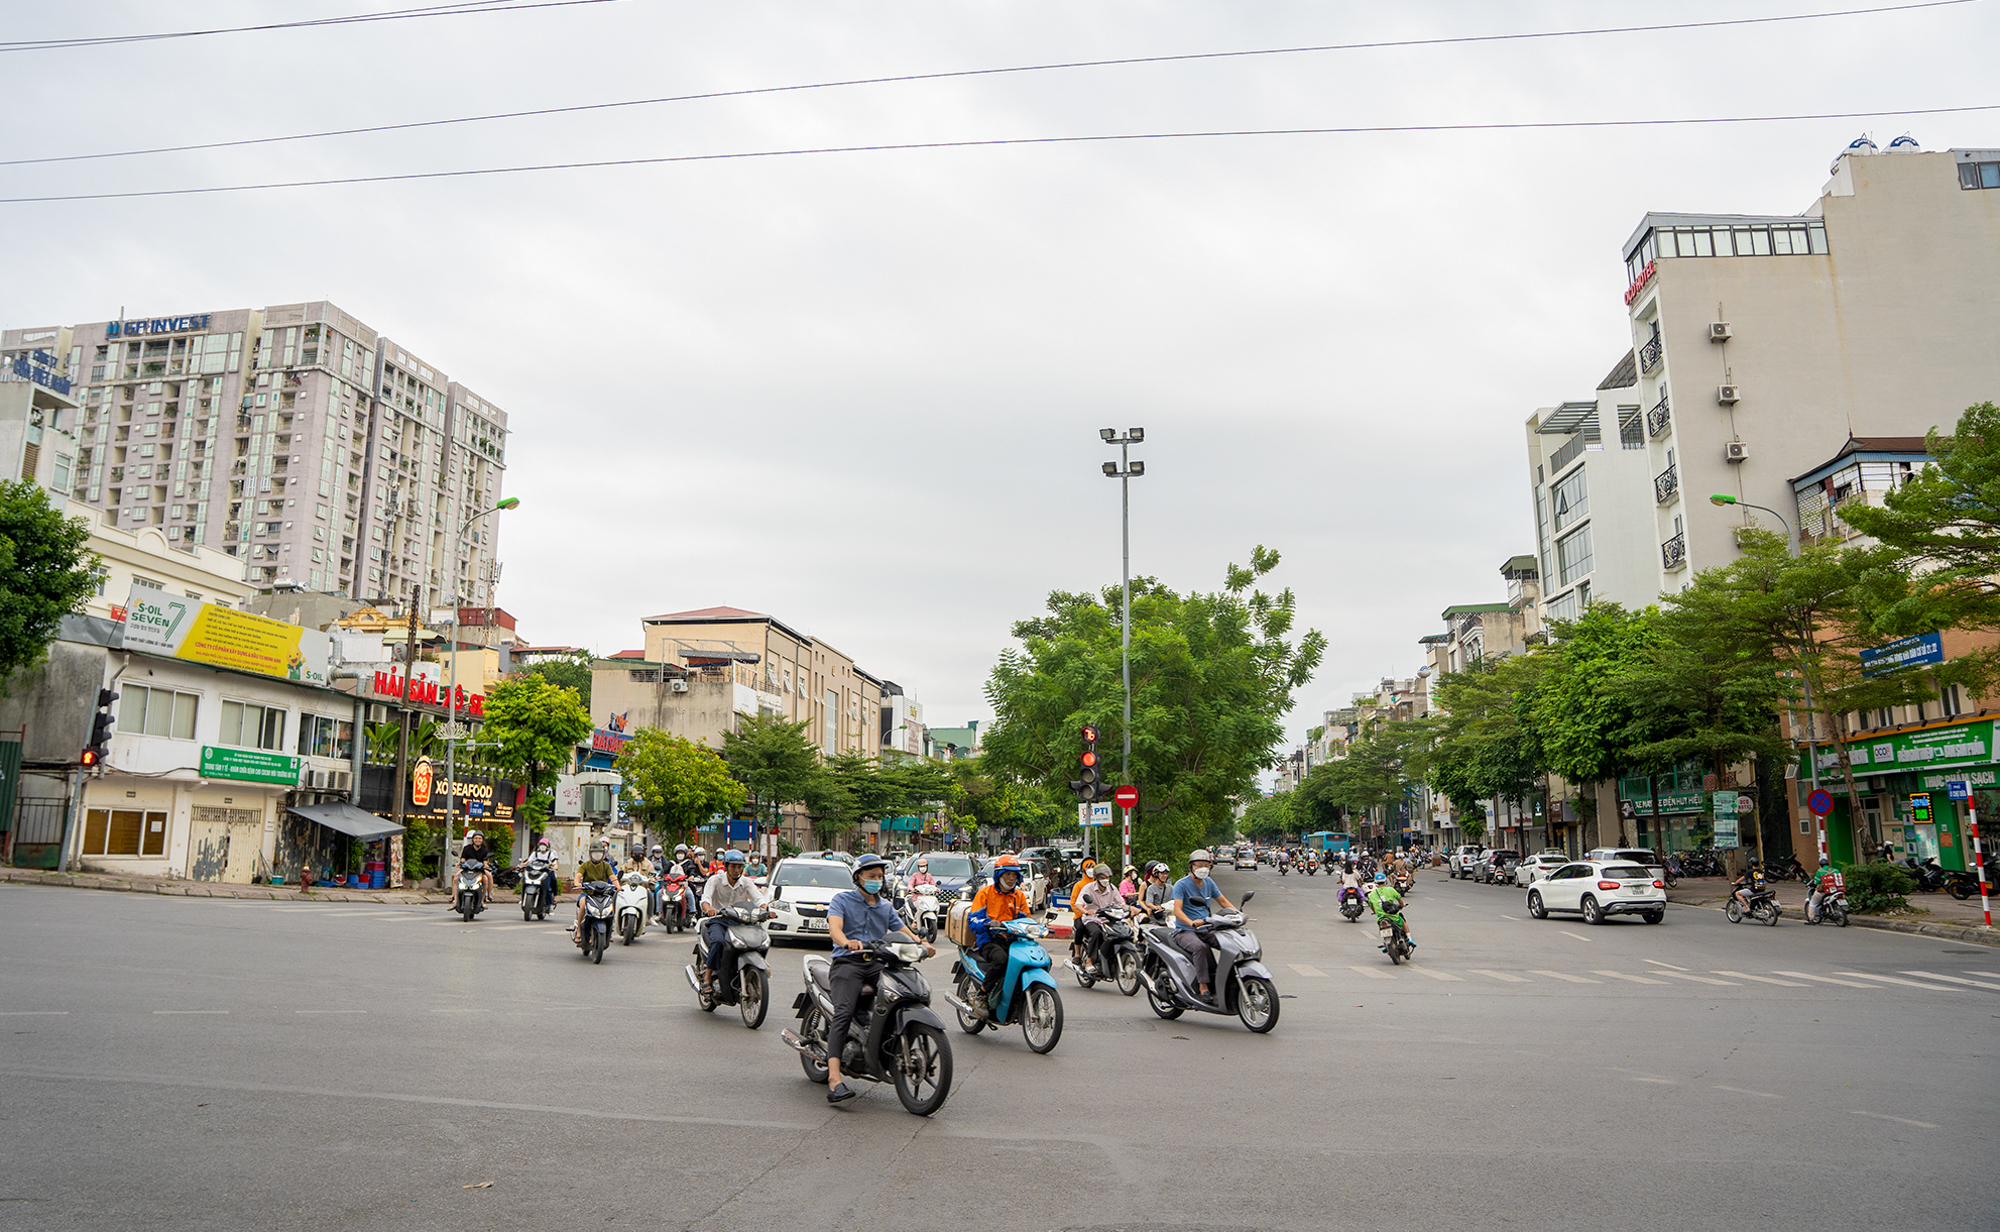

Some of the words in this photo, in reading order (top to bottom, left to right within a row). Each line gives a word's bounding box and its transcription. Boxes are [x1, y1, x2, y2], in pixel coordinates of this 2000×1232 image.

[131, 612, 170, 627] SEVEN
[374, 665, 404, 698] HẢI
[408, 672, 439, 705] SẢN
[1924, 774, 1945, 790] THỰC
[1971, 771, 1996, 787] SẠCH
[452, 781, 493, 799] SEAFOOD
[1094, 806, 1109, 815] PTI
